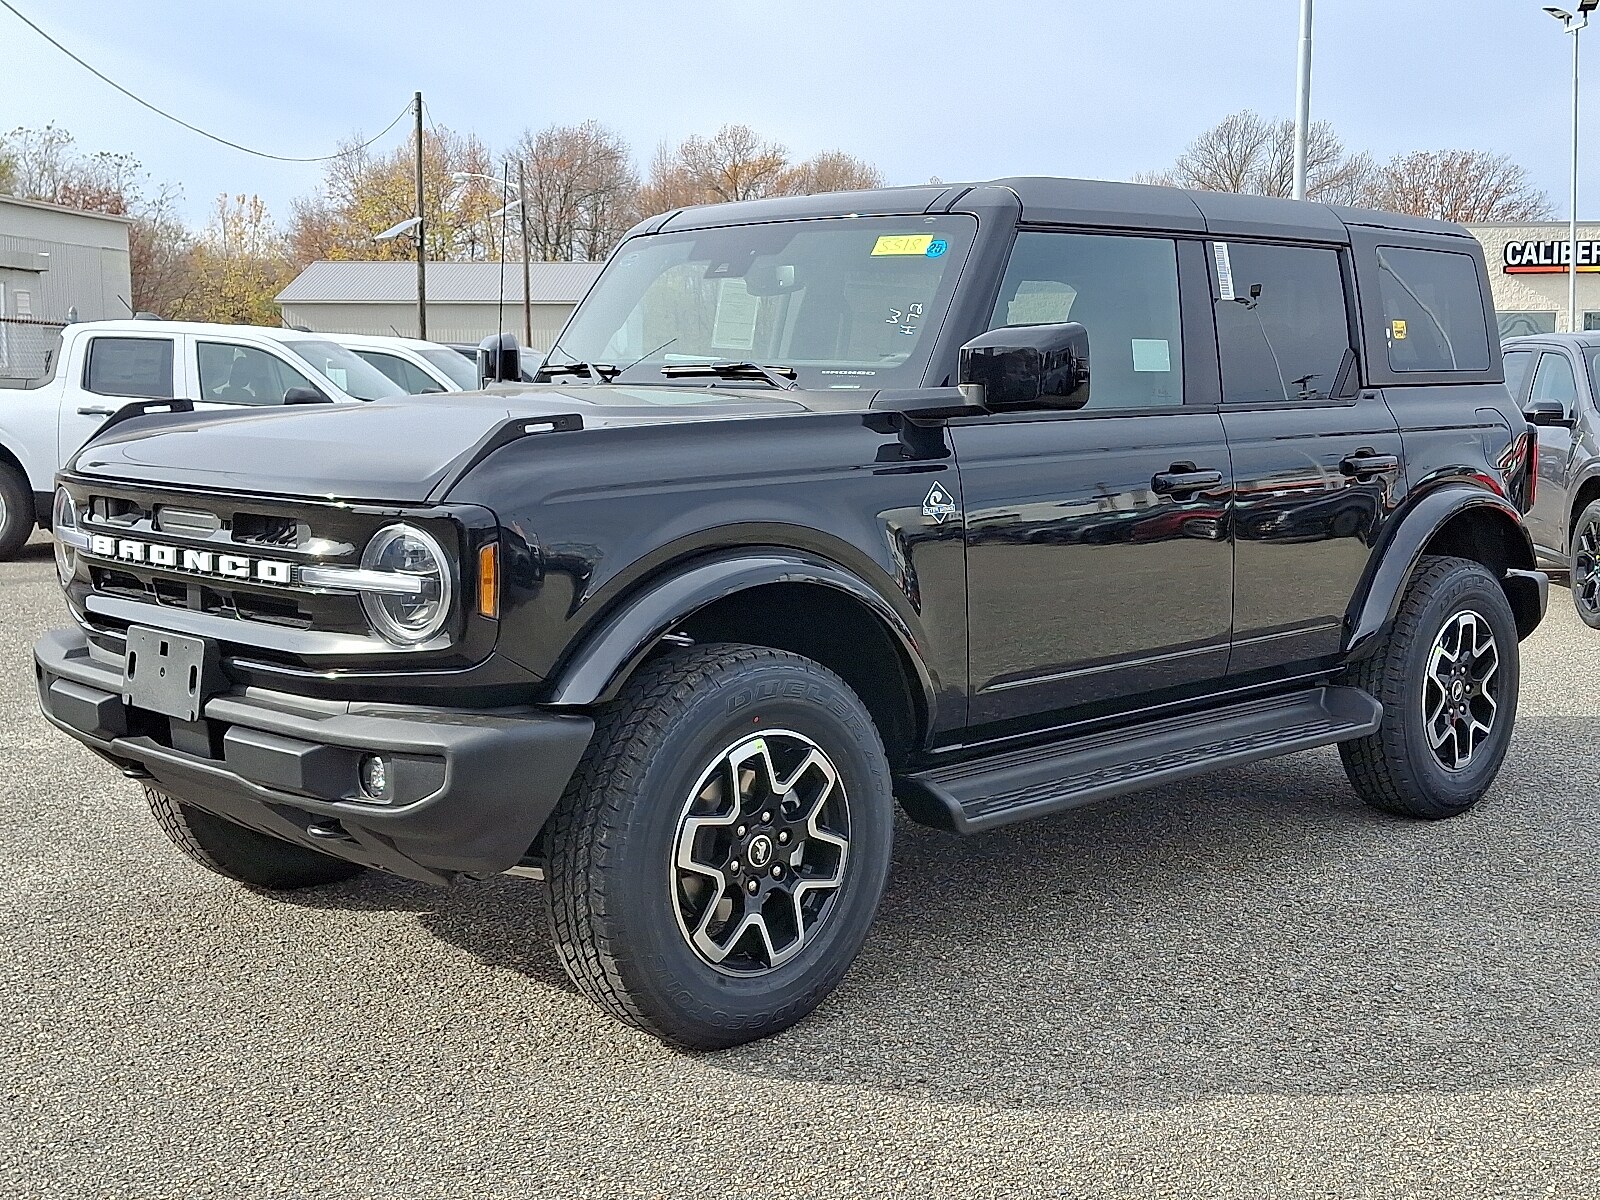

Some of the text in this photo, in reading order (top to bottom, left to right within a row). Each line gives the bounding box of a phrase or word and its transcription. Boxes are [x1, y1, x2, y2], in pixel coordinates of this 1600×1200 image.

[927, 242, 943, 254] 25
[92, 534, 291, 583] BRONCO
[725, 678, 867, 742] DUELER
